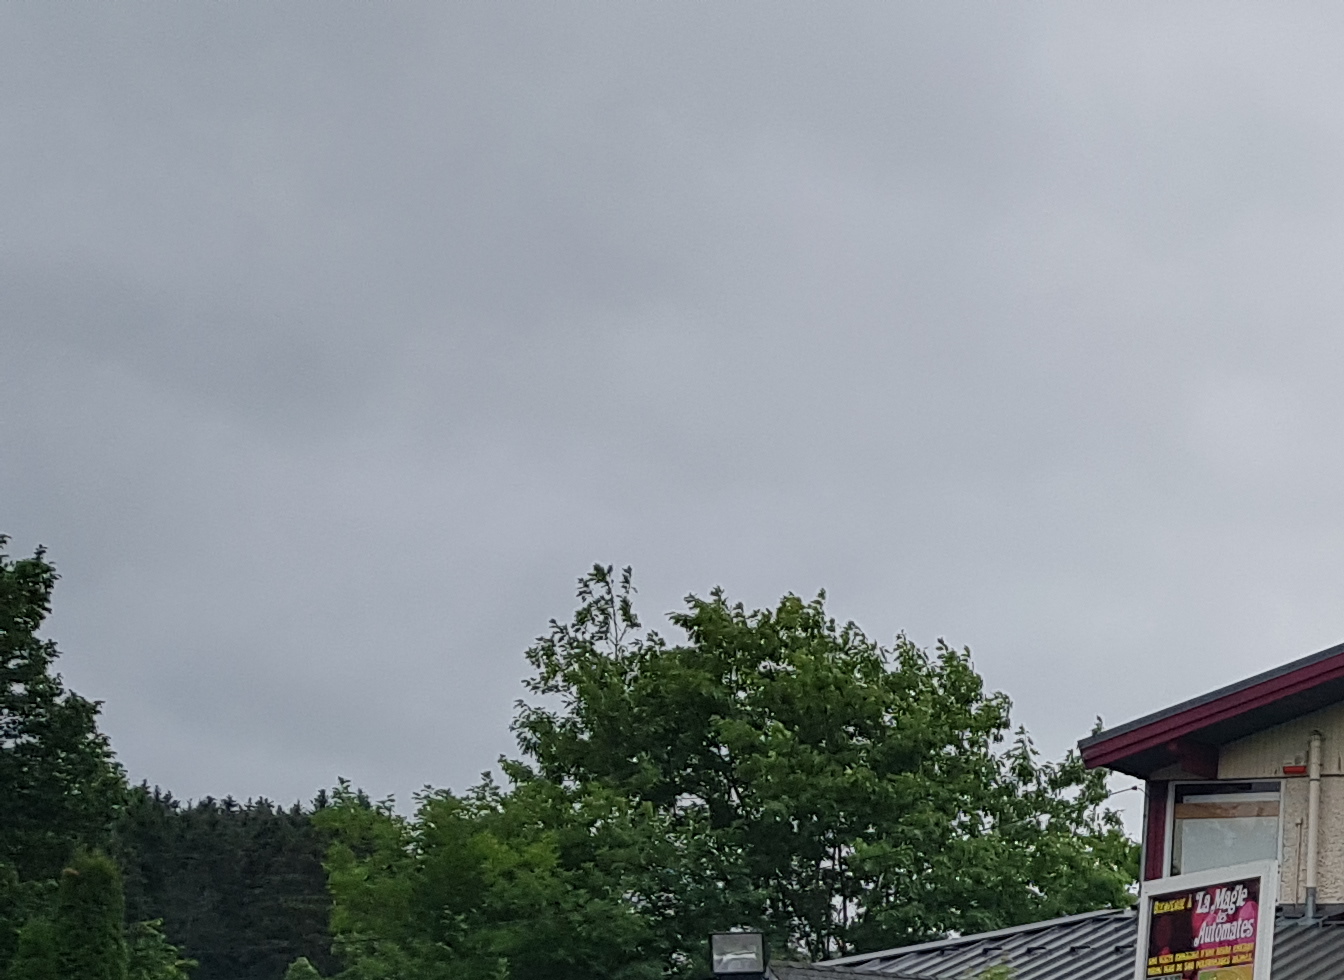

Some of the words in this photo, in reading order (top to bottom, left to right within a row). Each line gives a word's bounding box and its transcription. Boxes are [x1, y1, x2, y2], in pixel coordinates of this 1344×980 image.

[1195, 891, 1211, 913] La
[1210, 884, 1248, 915] Magie
[1193, 917, 1255, 948] Automates
